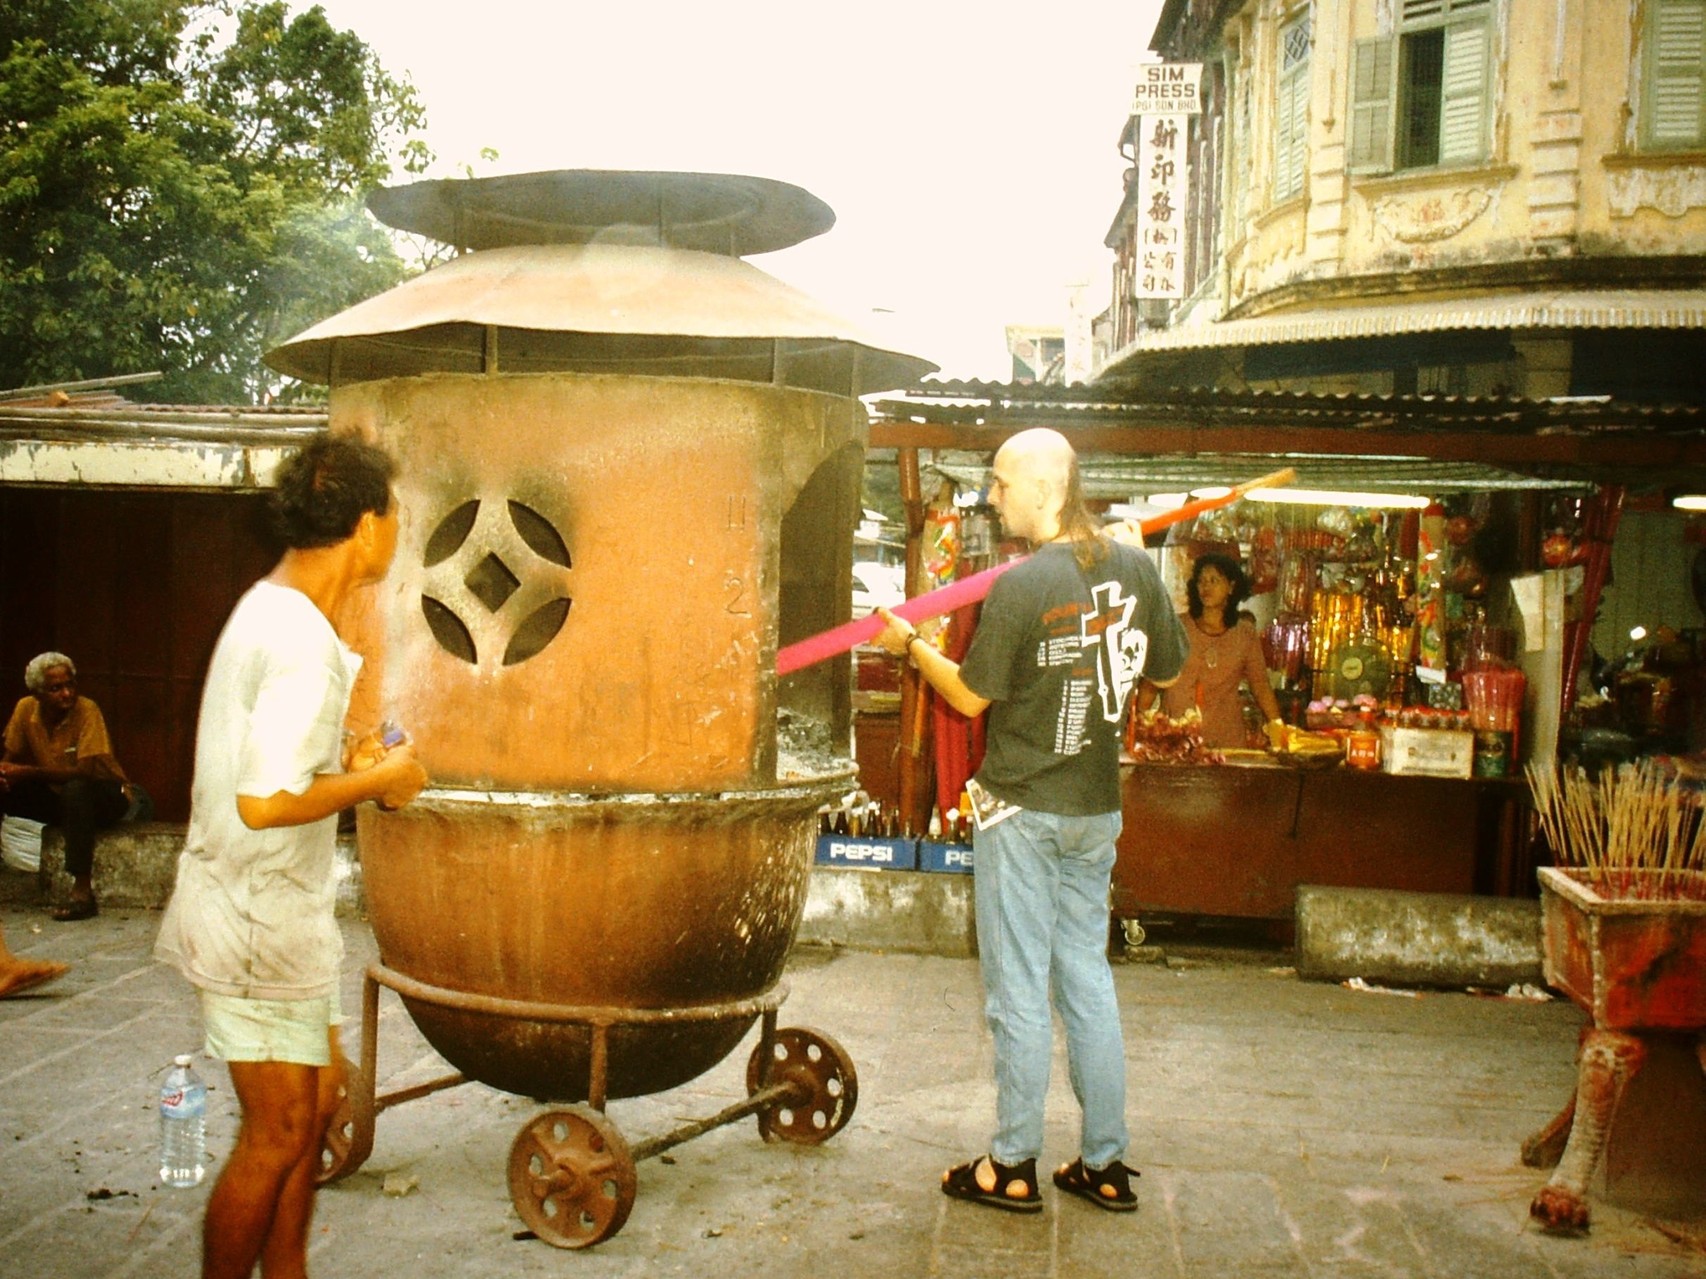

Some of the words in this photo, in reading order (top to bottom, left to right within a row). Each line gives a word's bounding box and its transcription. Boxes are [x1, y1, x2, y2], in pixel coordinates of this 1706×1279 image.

[1147, 67, 1184, 82] SIM
[1135, 83, 1195, 98] PRESS
[830, 842, 893, 862] PEPSI
